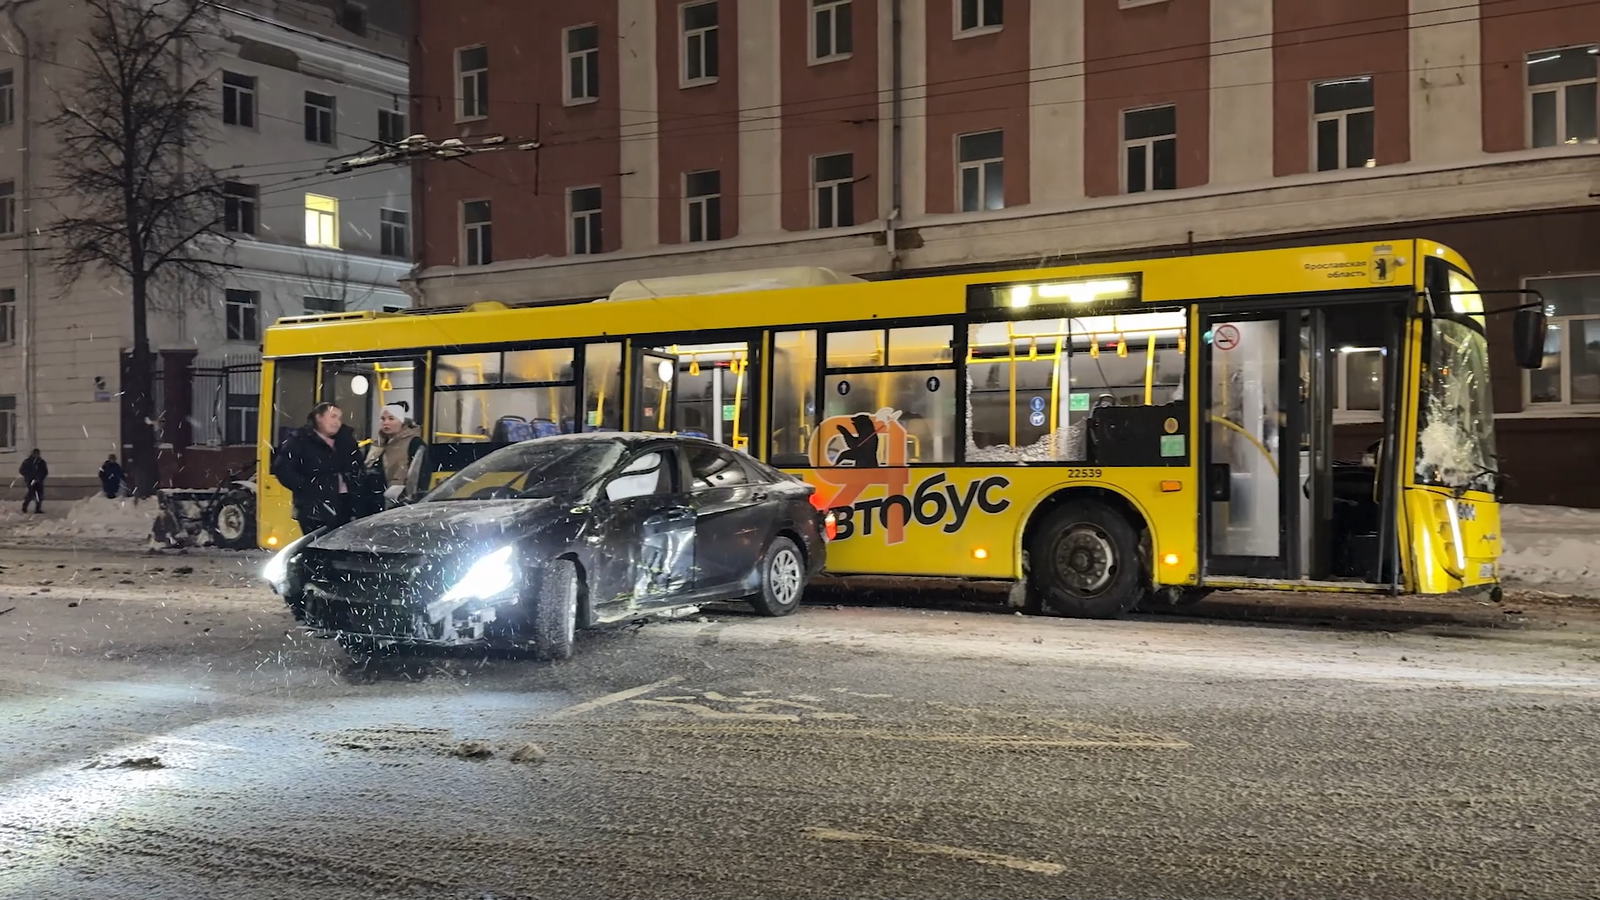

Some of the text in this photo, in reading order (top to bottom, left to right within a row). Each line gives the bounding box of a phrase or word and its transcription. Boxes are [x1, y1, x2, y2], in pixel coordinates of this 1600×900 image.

[1304, 260, 1367, 270] Ярославская
[1327, 270, 1366, 279] область
[1067, 468, 1102, 478] 22539
[820, 472, 1010, 541] втобус
